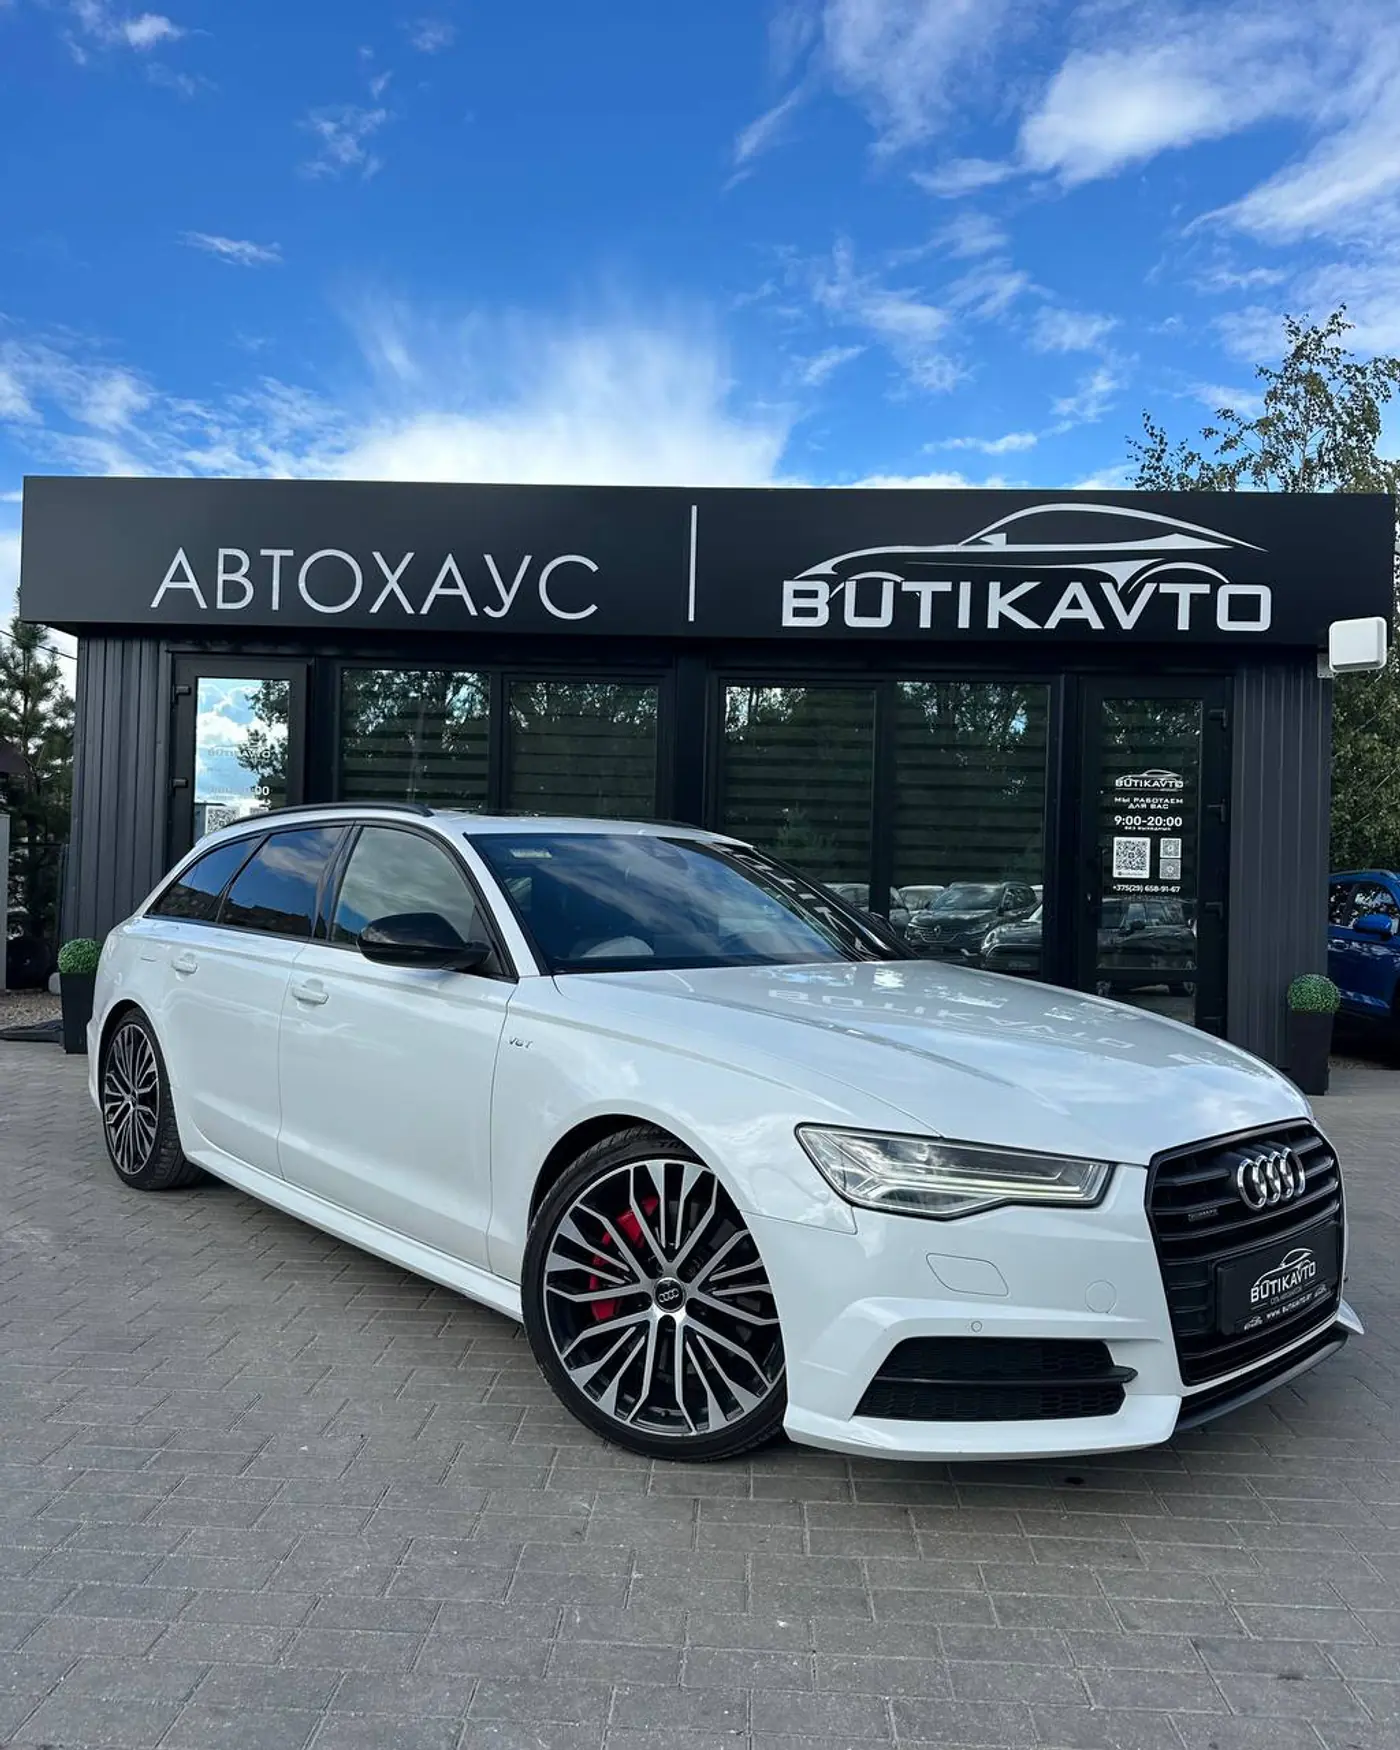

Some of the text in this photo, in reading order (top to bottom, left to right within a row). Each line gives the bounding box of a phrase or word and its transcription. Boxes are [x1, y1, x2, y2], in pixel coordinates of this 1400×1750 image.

[150, 547, 600, 620] АВТОХАУС
[781, 579, 1272, 632] BUTIKAVTO
[1115, 778, 1184, 788] BUTIKAVTO
[1114, 815, 1183, 827] 9:00-20:00
[1251, 1260, 1317, 1303] BUTIKAVTO
